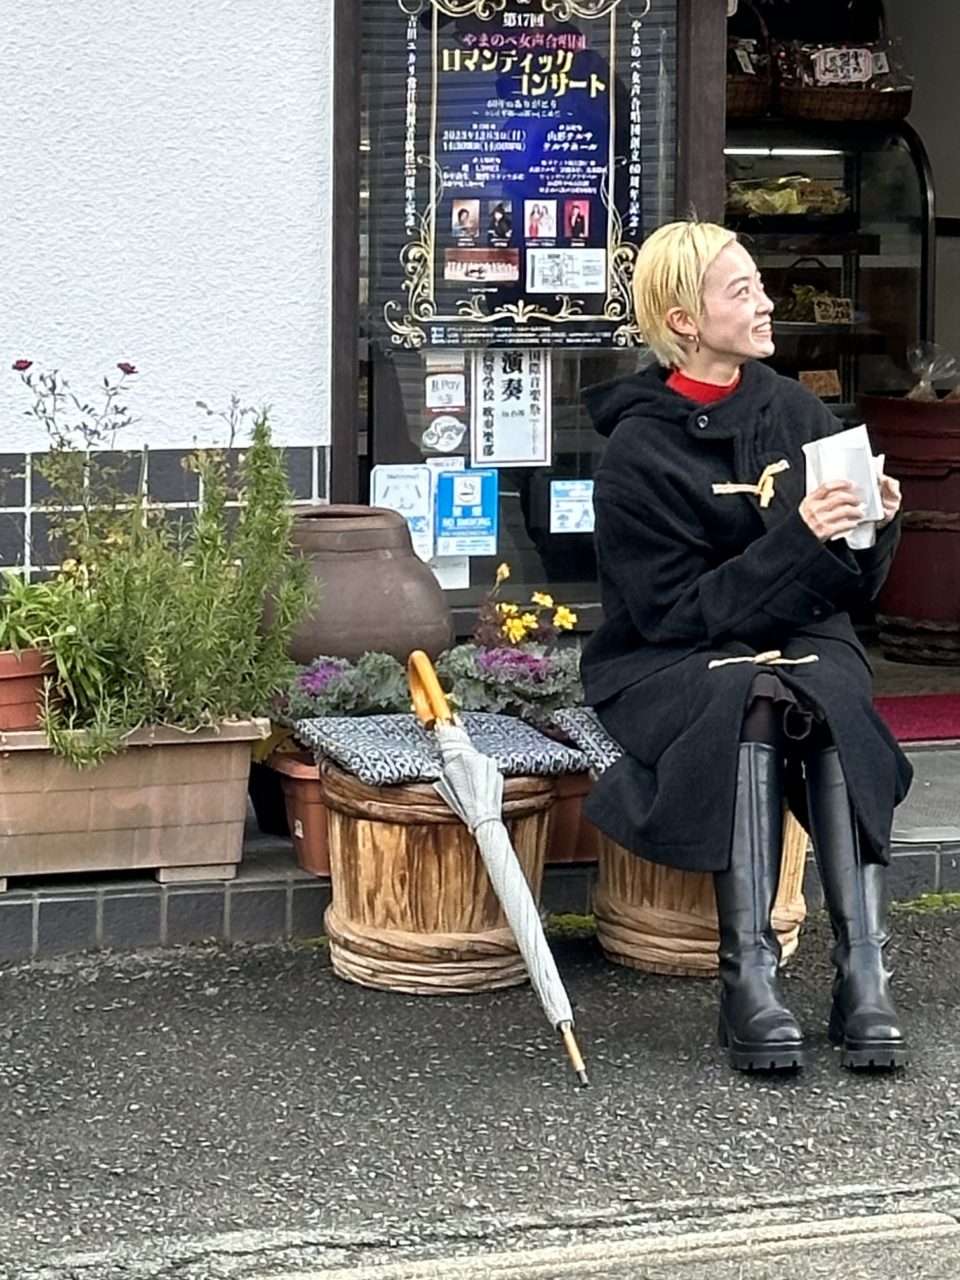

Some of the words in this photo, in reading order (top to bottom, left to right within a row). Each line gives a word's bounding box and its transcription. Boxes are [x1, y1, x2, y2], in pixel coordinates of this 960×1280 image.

[502, 12, 544, 28] 第17回
[443, 49, 574, 73] ロマンティック
[511, 73, 606, 98] コンサート
[501, 350, 524, 402] 演奏
